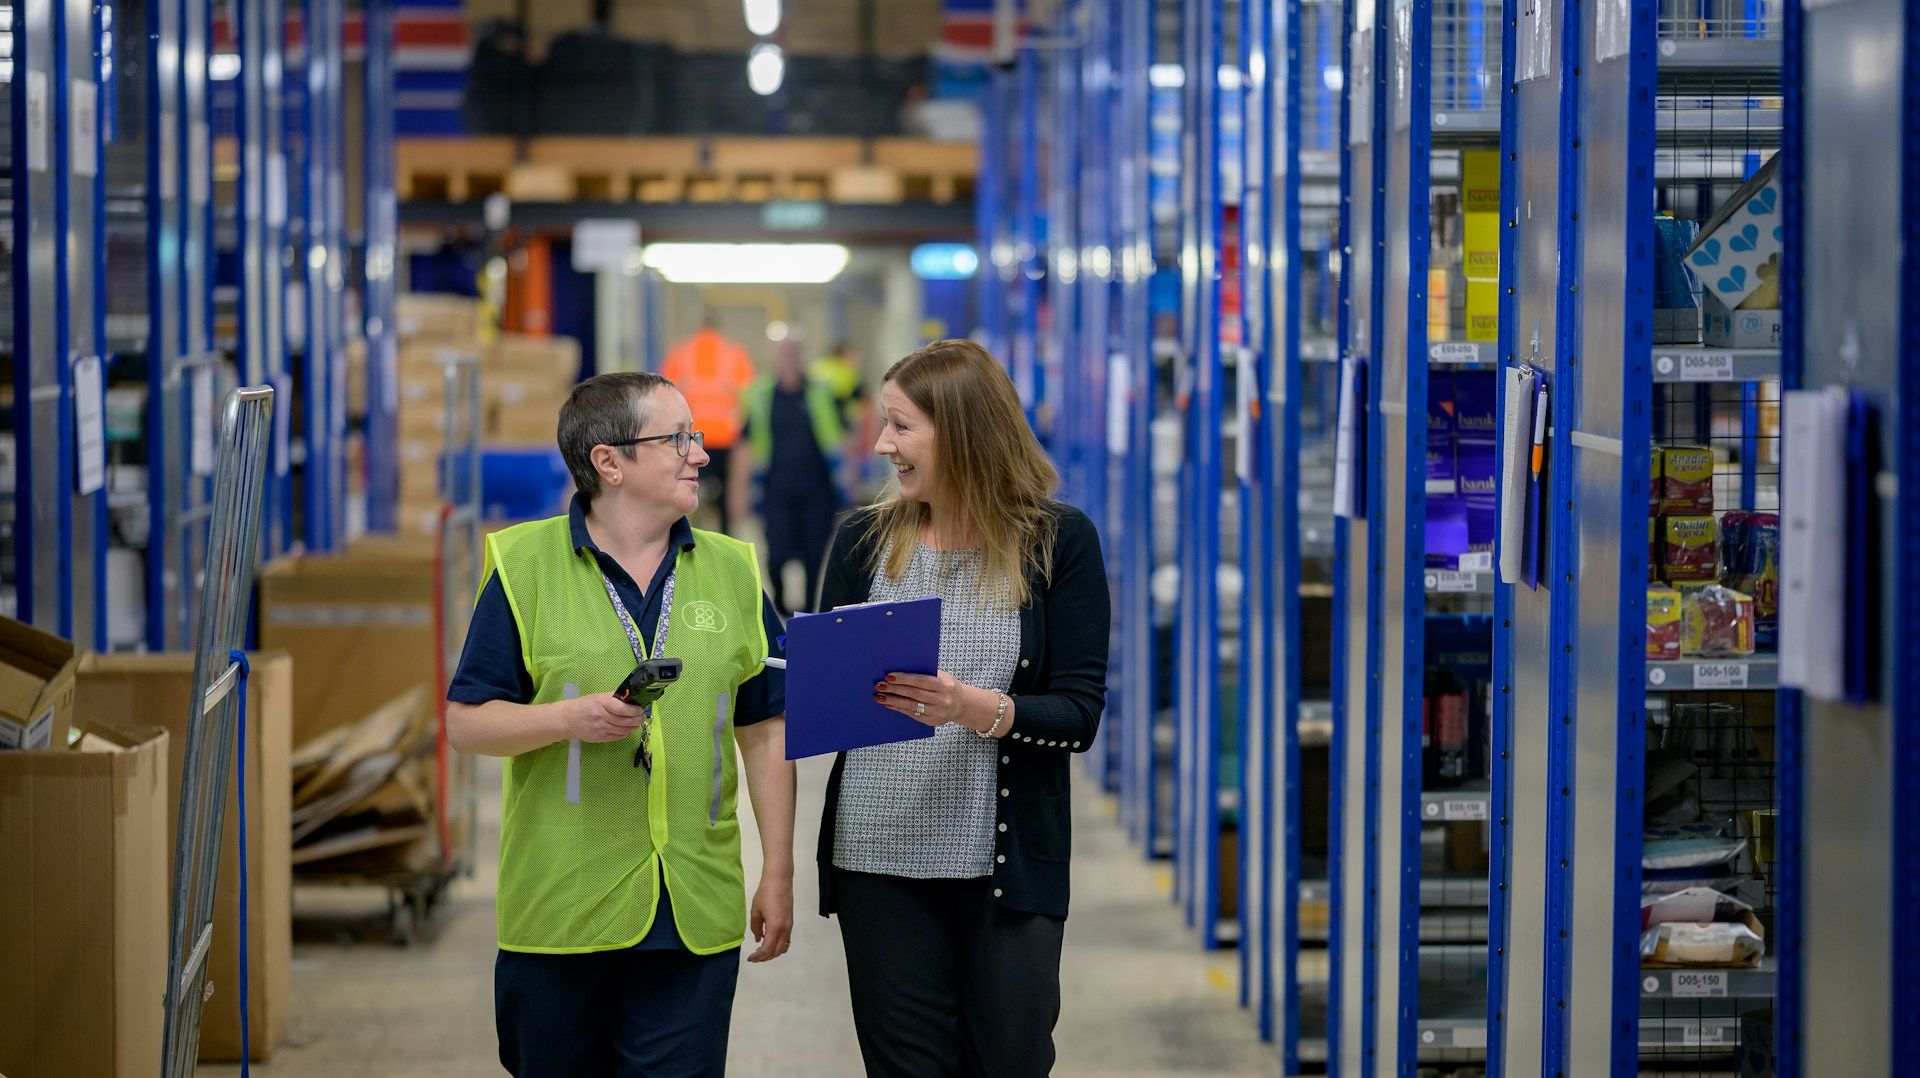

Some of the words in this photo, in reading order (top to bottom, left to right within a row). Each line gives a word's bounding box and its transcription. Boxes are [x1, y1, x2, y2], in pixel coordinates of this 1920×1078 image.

[1460, 475, 1495, 489] bazuk
[1699, 666, 1741, 677] D05-100
[1678, 974, 1720, 986] D05-150
